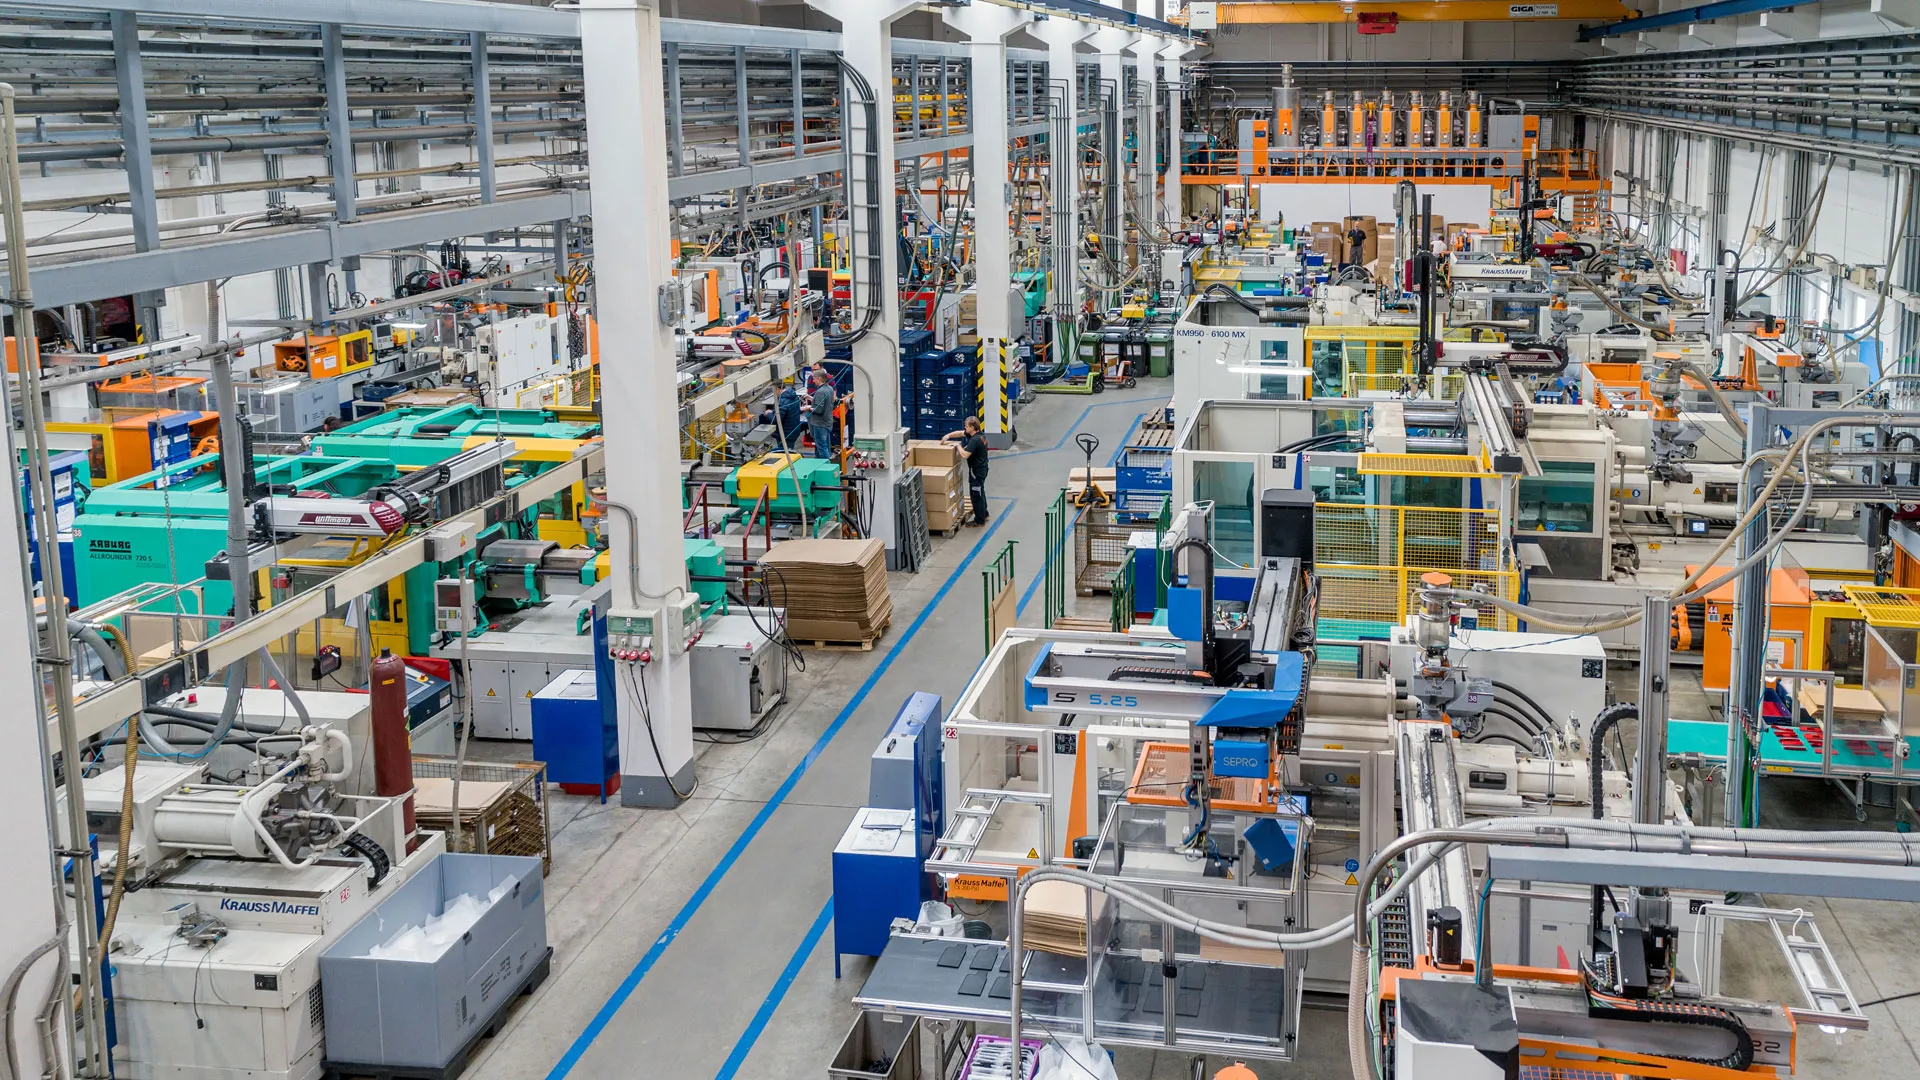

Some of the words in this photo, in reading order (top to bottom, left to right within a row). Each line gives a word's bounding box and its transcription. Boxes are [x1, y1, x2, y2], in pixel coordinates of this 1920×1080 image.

[1176, 329, 1204, 337] KM950
[1211, 330, 1230, 338] 6100
[89, 539, 131, 549] ARBURG
[89, 553, 132, 561] ALLROUNDER
[1708, 605, 1718, 614] 44
[1053, 692, 1077, 703] S
[1089, 693, 1138, 707] 5.25
[946, 728, 957, 739] 23
[1223, 756, 1258, 768] SEPRO
[954, 878, 980, 887] Krauss
[981, 879, 1005, 888] Maffei
[220, 898, 319, 916] KRAUSSMAFFEI
